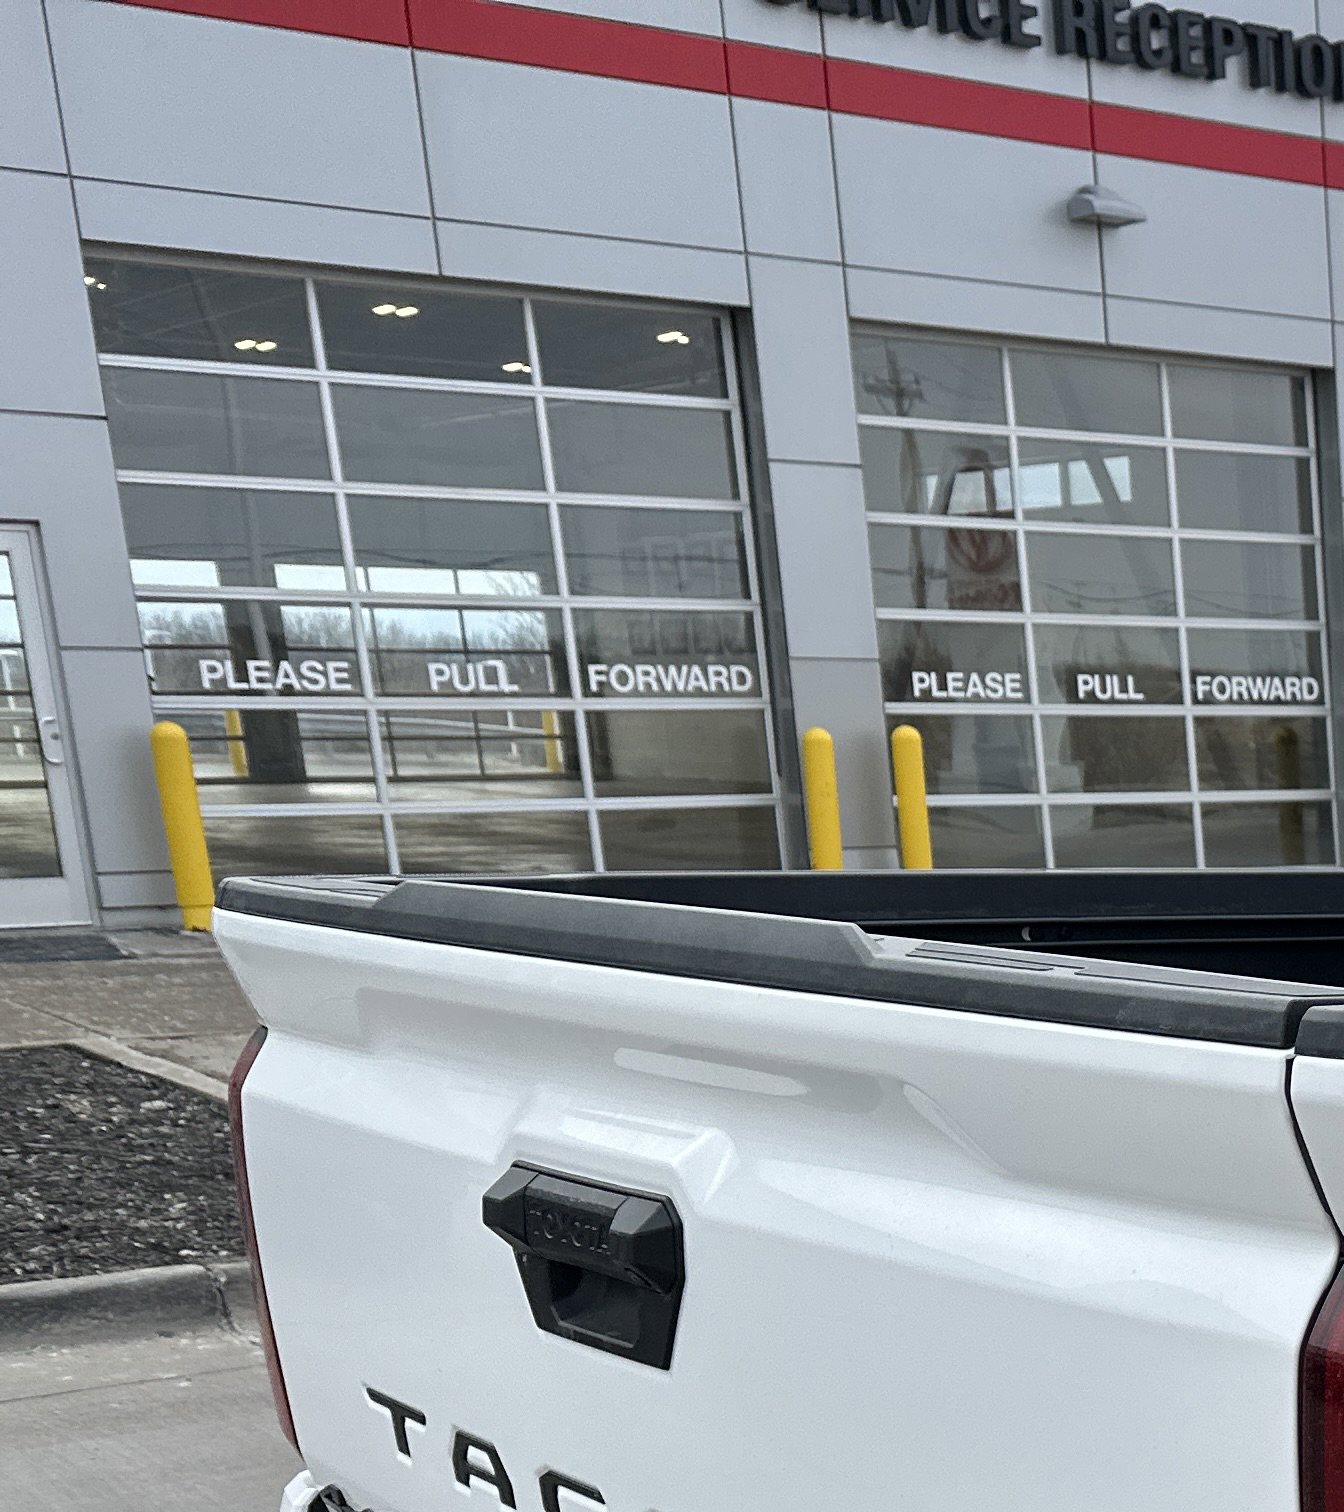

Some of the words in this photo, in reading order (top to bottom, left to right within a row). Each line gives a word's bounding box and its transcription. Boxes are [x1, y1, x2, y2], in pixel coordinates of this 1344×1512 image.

[199, 659, 352, 691] PLEASE
[427, 659, 519, 693] PULL
[587, 663, 752, 694] FORWARD
[911, 671, 1024, 699] PLEASE
[1077, 673, 1145, 700] PULL
[1195, 675, 1320, 701] FORWARD
